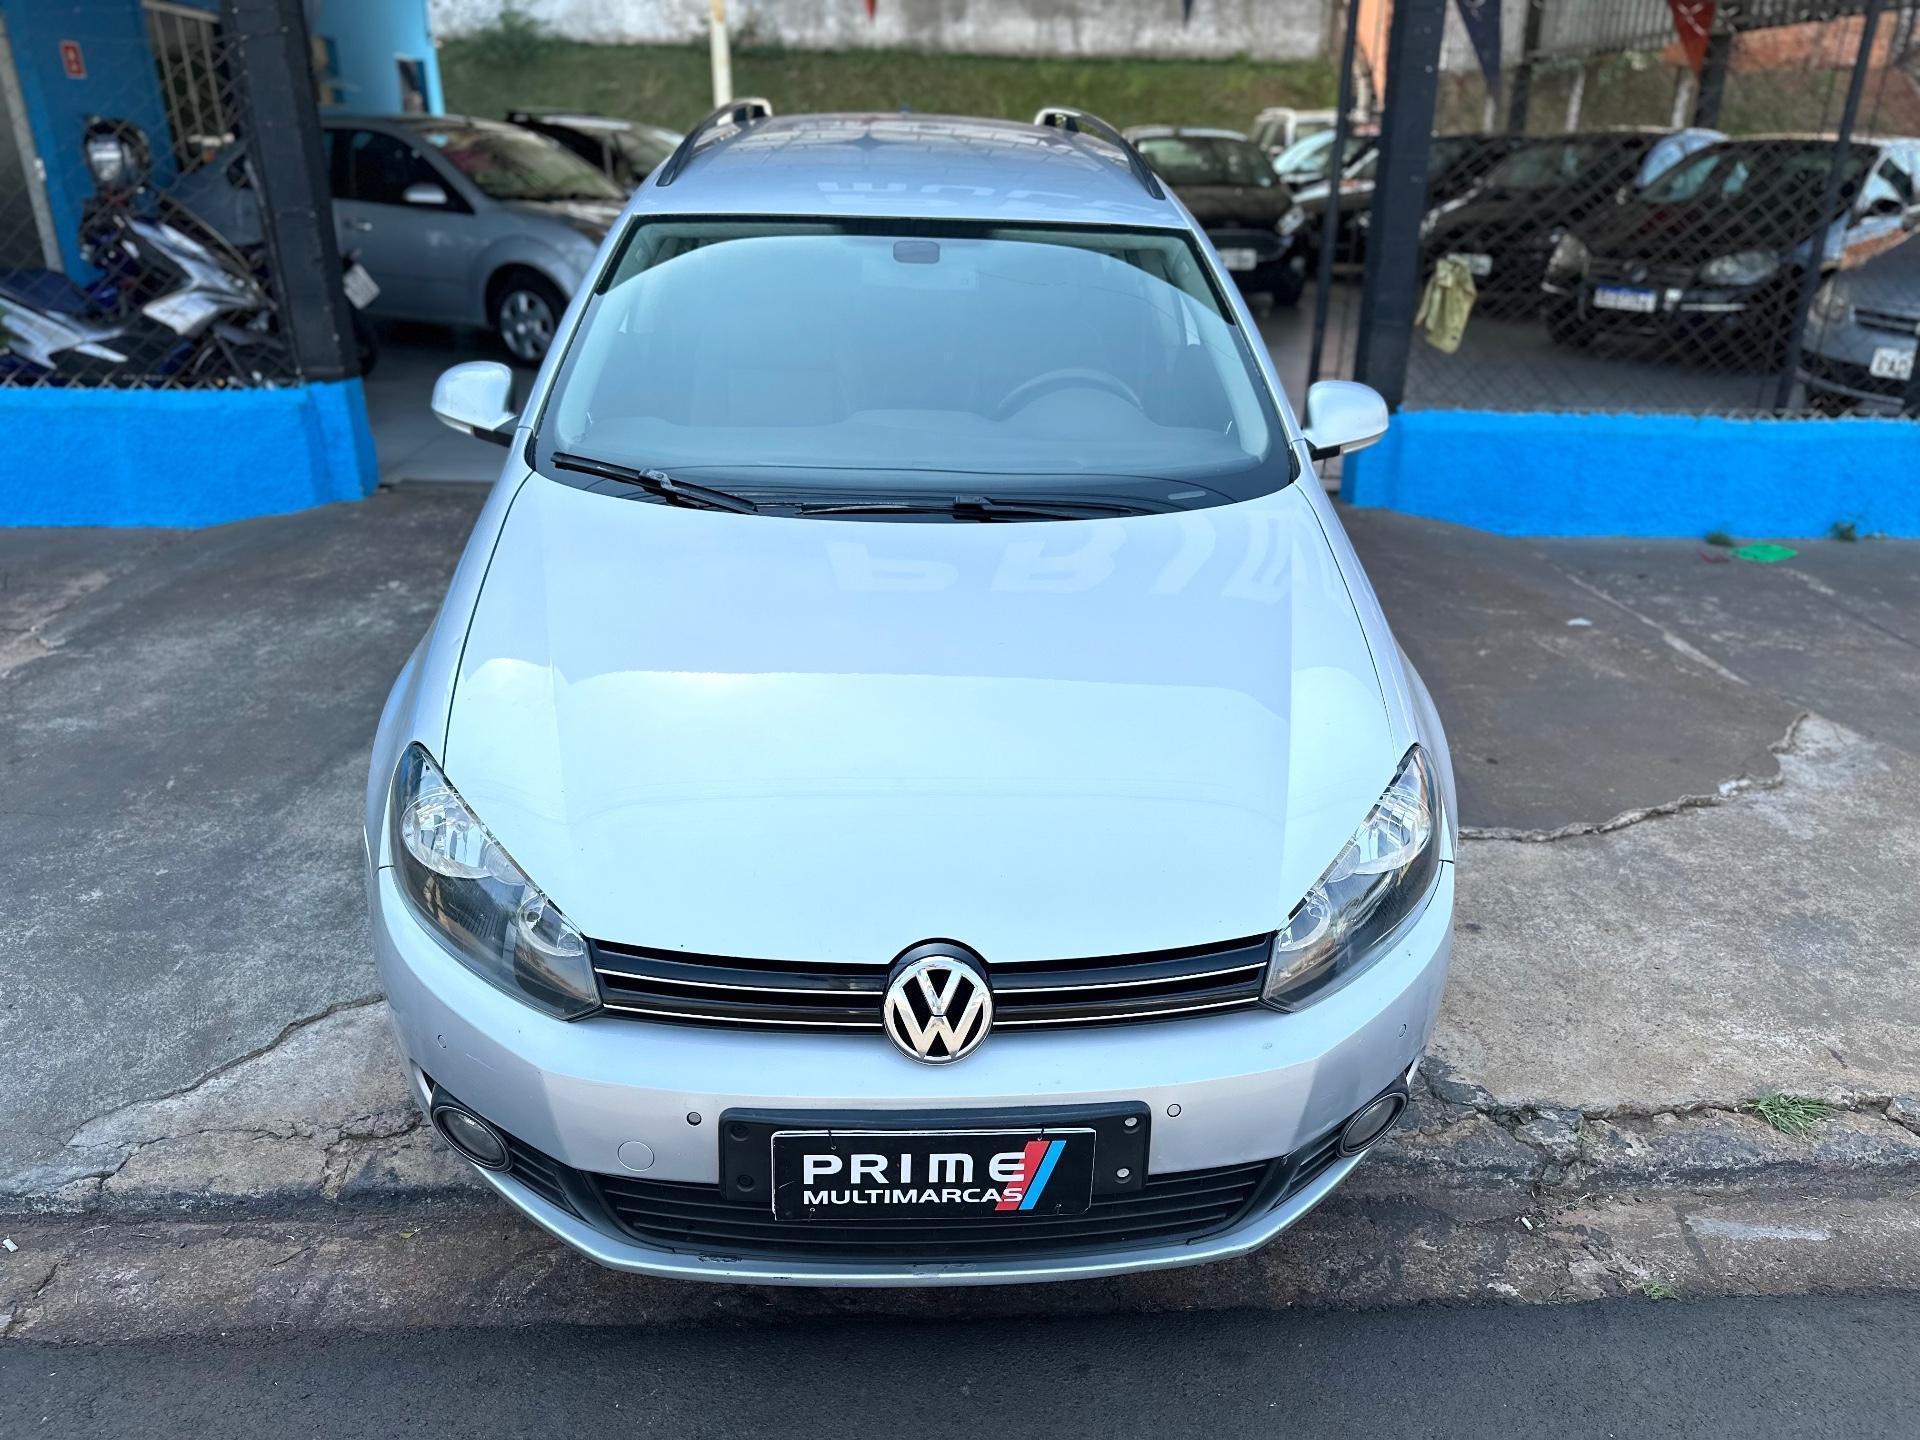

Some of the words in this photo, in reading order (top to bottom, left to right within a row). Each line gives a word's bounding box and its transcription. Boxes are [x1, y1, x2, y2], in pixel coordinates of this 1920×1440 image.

[884, 955, 993, 1065] VW
[803, 1151, 1026, 1185] PRIME
[803, 1187, 1023, 1205] MULTIMARCAS
